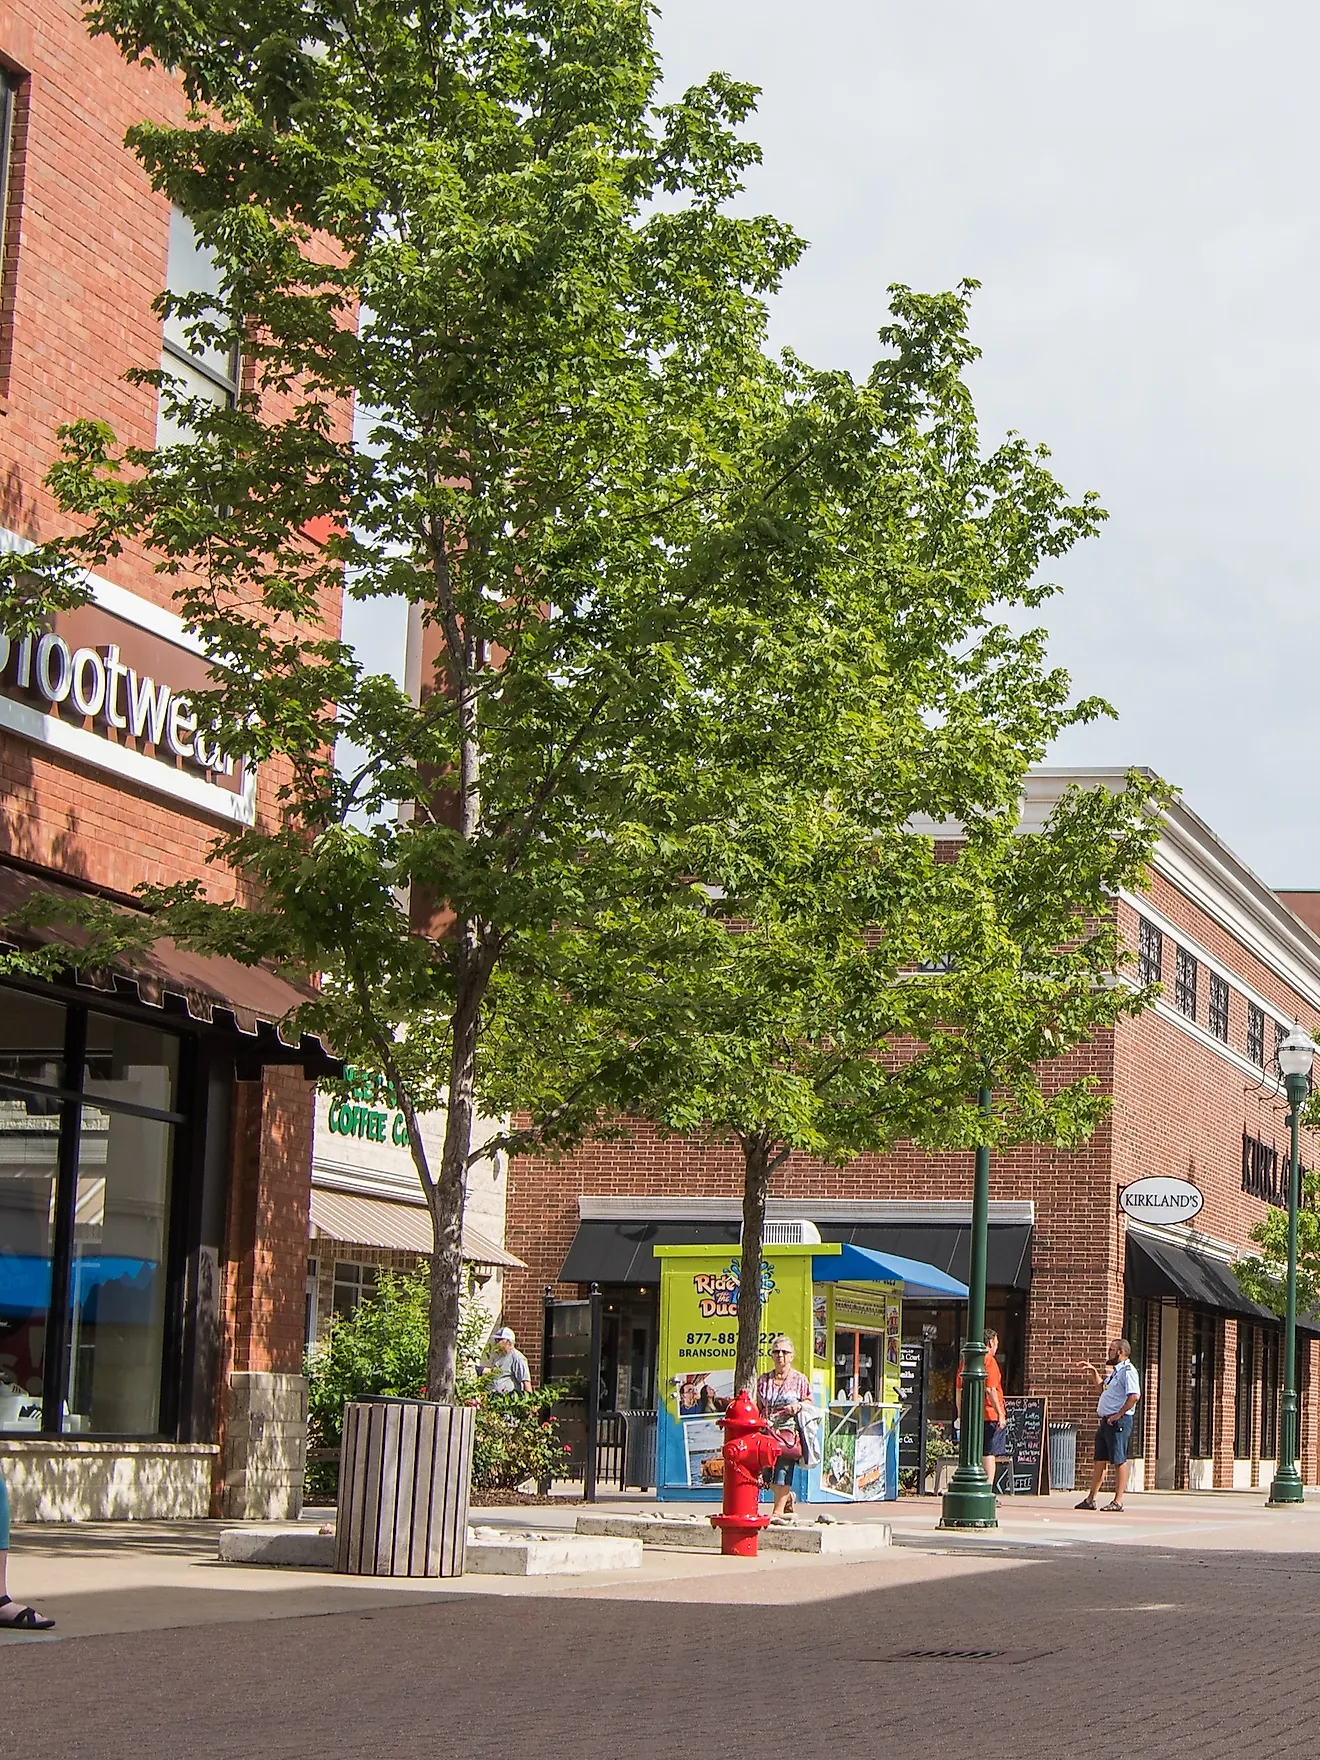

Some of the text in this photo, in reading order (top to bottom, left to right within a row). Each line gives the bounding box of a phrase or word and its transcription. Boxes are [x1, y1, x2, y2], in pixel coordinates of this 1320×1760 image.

[328, 1098, 388, 1143] COFFEE
[1125, 1193, 1199, 1208] KIRKLAND'S
[693, 1273, 737, 1295] Ride
